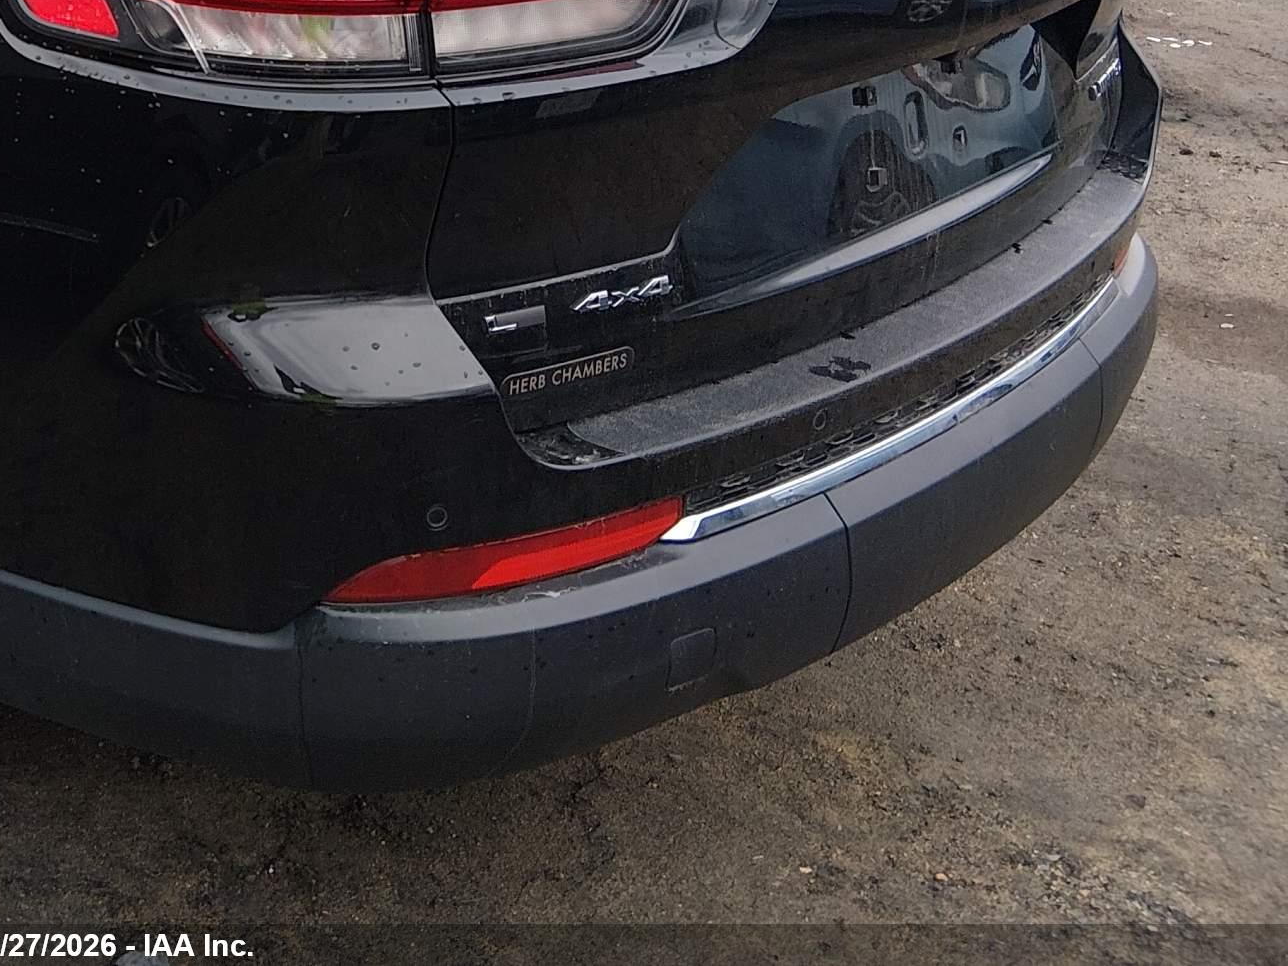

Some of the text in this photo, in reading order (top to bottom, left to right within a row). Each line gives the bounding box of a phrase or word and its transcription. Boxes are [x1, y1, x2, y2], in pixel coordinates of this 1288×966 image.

[484, 315, 517, 333] L
[509, 352, 628, 395] HERB CHAMBERS
